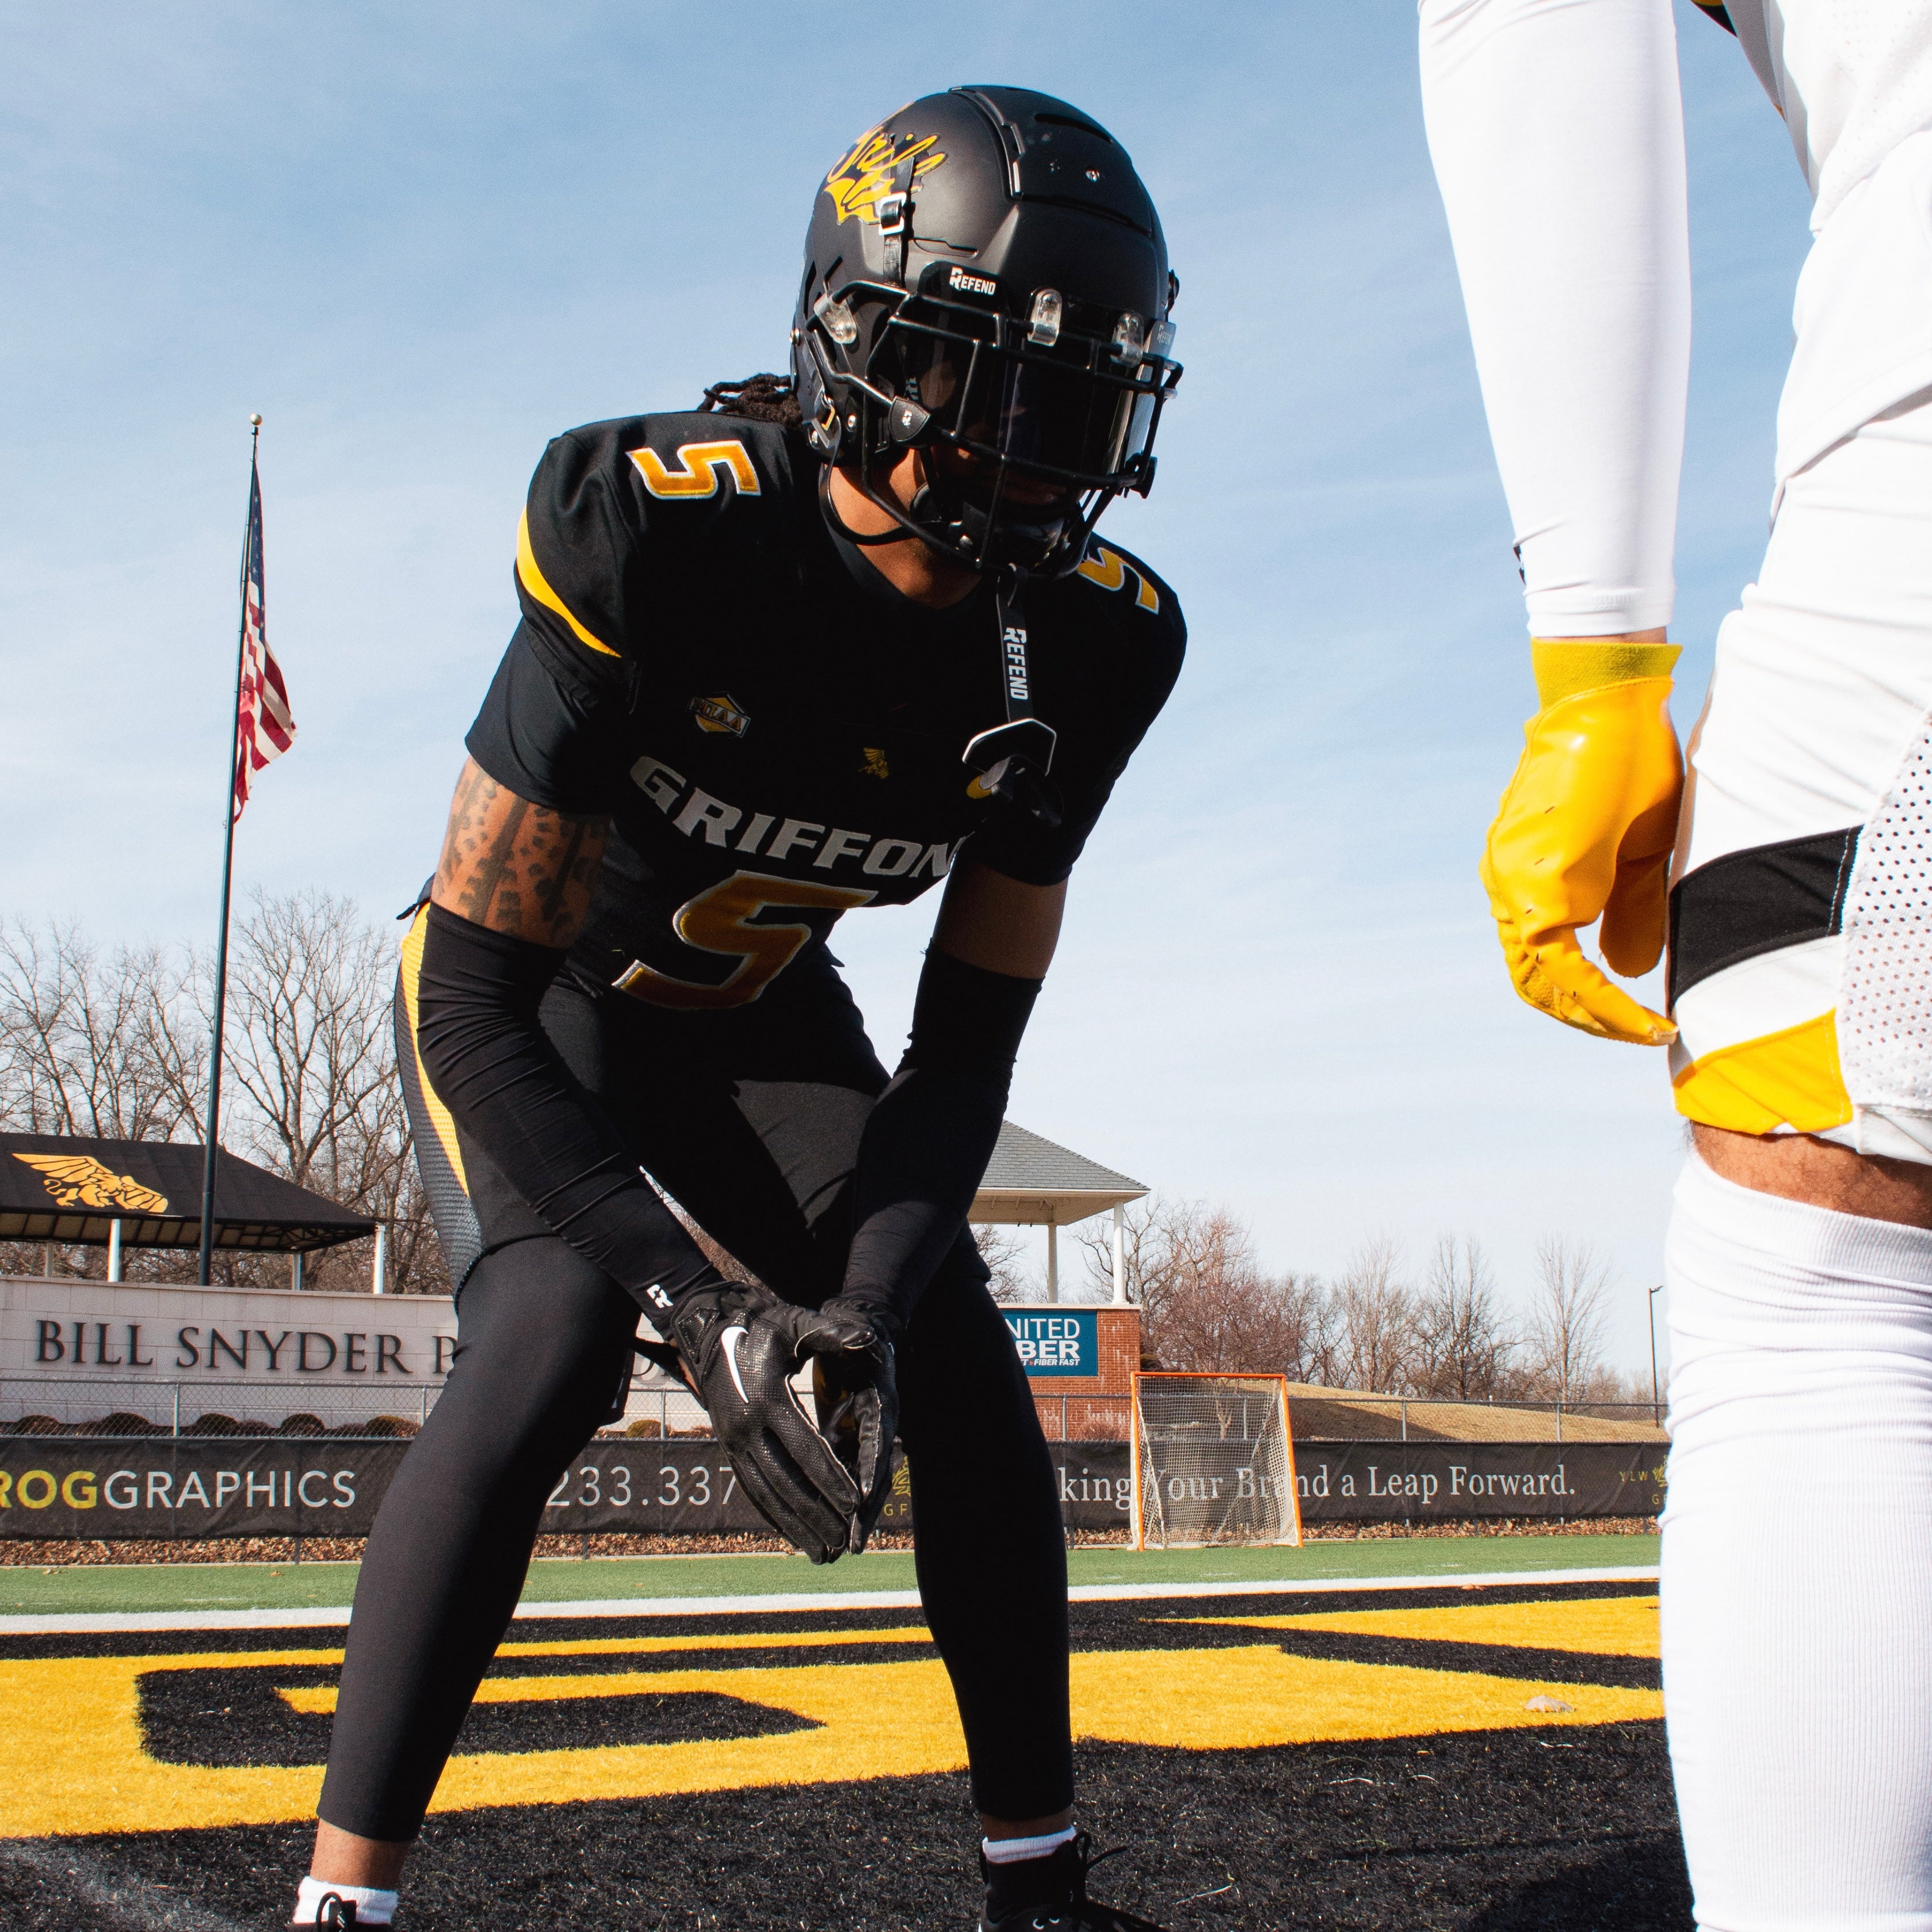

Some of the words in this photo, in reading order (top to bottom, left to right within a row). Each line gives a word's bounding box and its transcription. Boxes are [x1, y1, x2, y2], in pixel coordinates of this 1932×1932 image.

[949, 266, 996, 295] REFEND
[625, 440, 761, 499] 5
[1003, 627, 1028, 700] REFEND
[612, 869, 879, 1010] 5
[36, 1319, 153, 1366] BILL
[177, 1326, 413, 1374] SNYDER
[1341, 1473, 1357, 1496] a
[1368, 1467, 1438, 1505] Leap
[1449, 1464, 1576, 1496] Forward.
